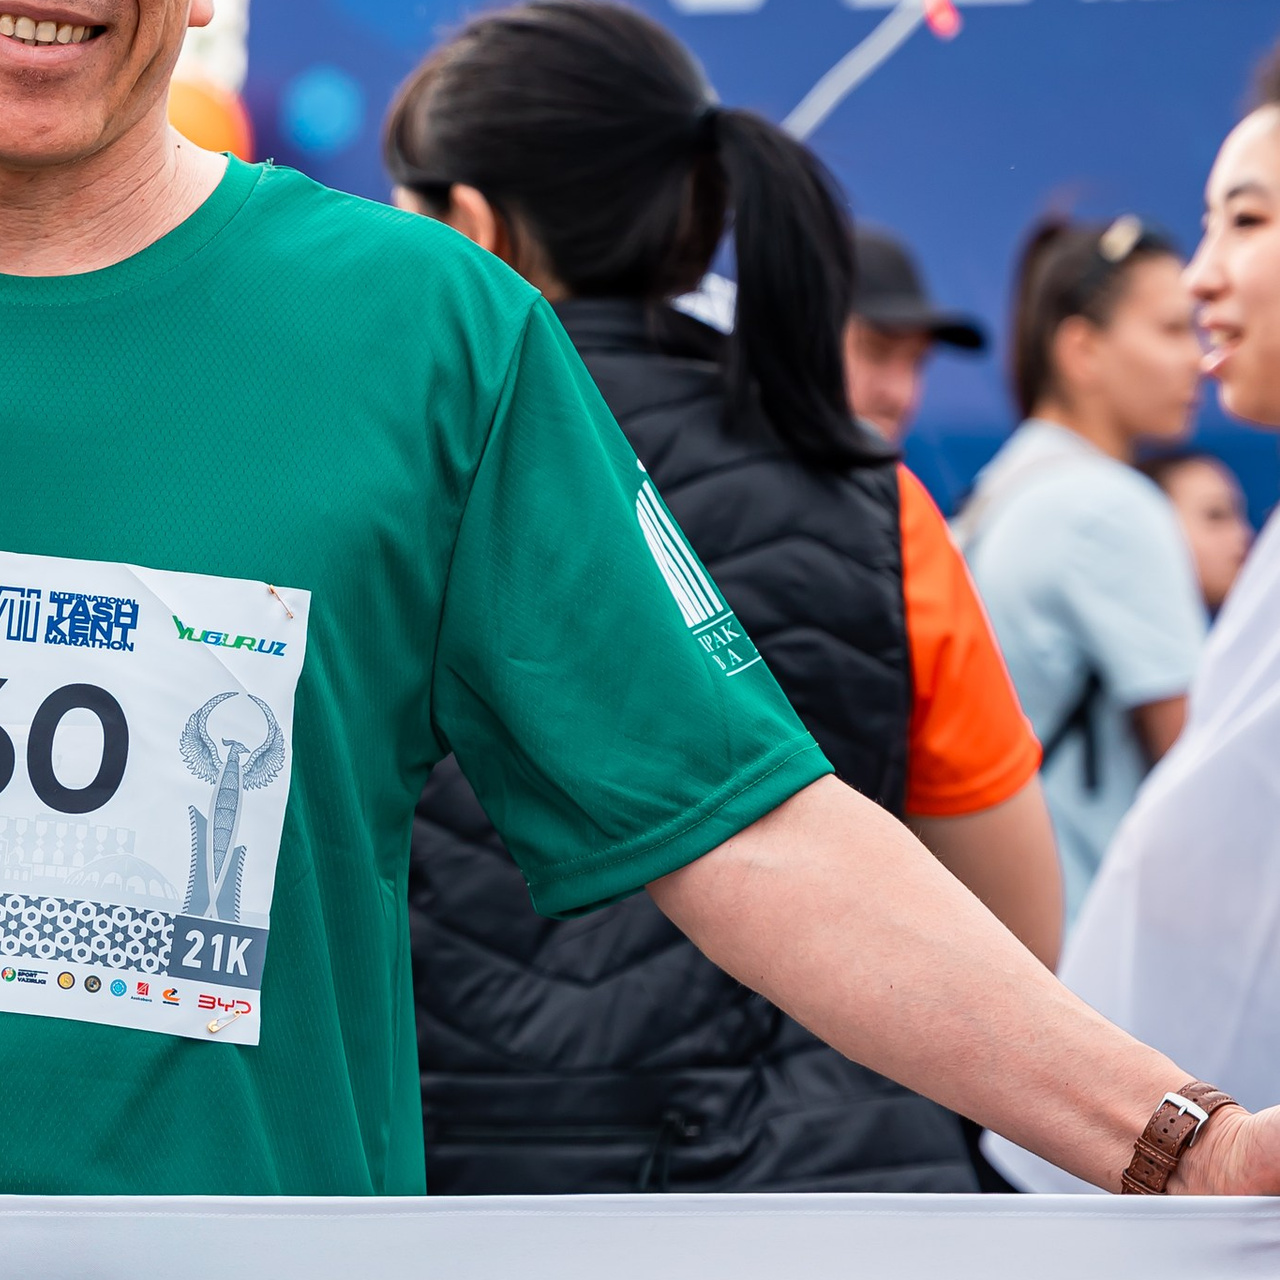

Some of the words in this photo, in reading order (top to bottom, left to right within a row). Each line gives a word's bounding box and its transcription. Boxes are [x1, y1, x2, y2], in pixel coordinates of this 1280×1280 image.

[50, 591, 137, 606] INTERNATIONAL
[49, 598, 139, 629] TASH
[44, 634, 134, 652] MARATHON
[46, 616, 137, 643] KENT
[698, 621, 741, 653] IPAK
[181, 928, 254, 977] 21K
[197, 993, 252, 1015] BYD
